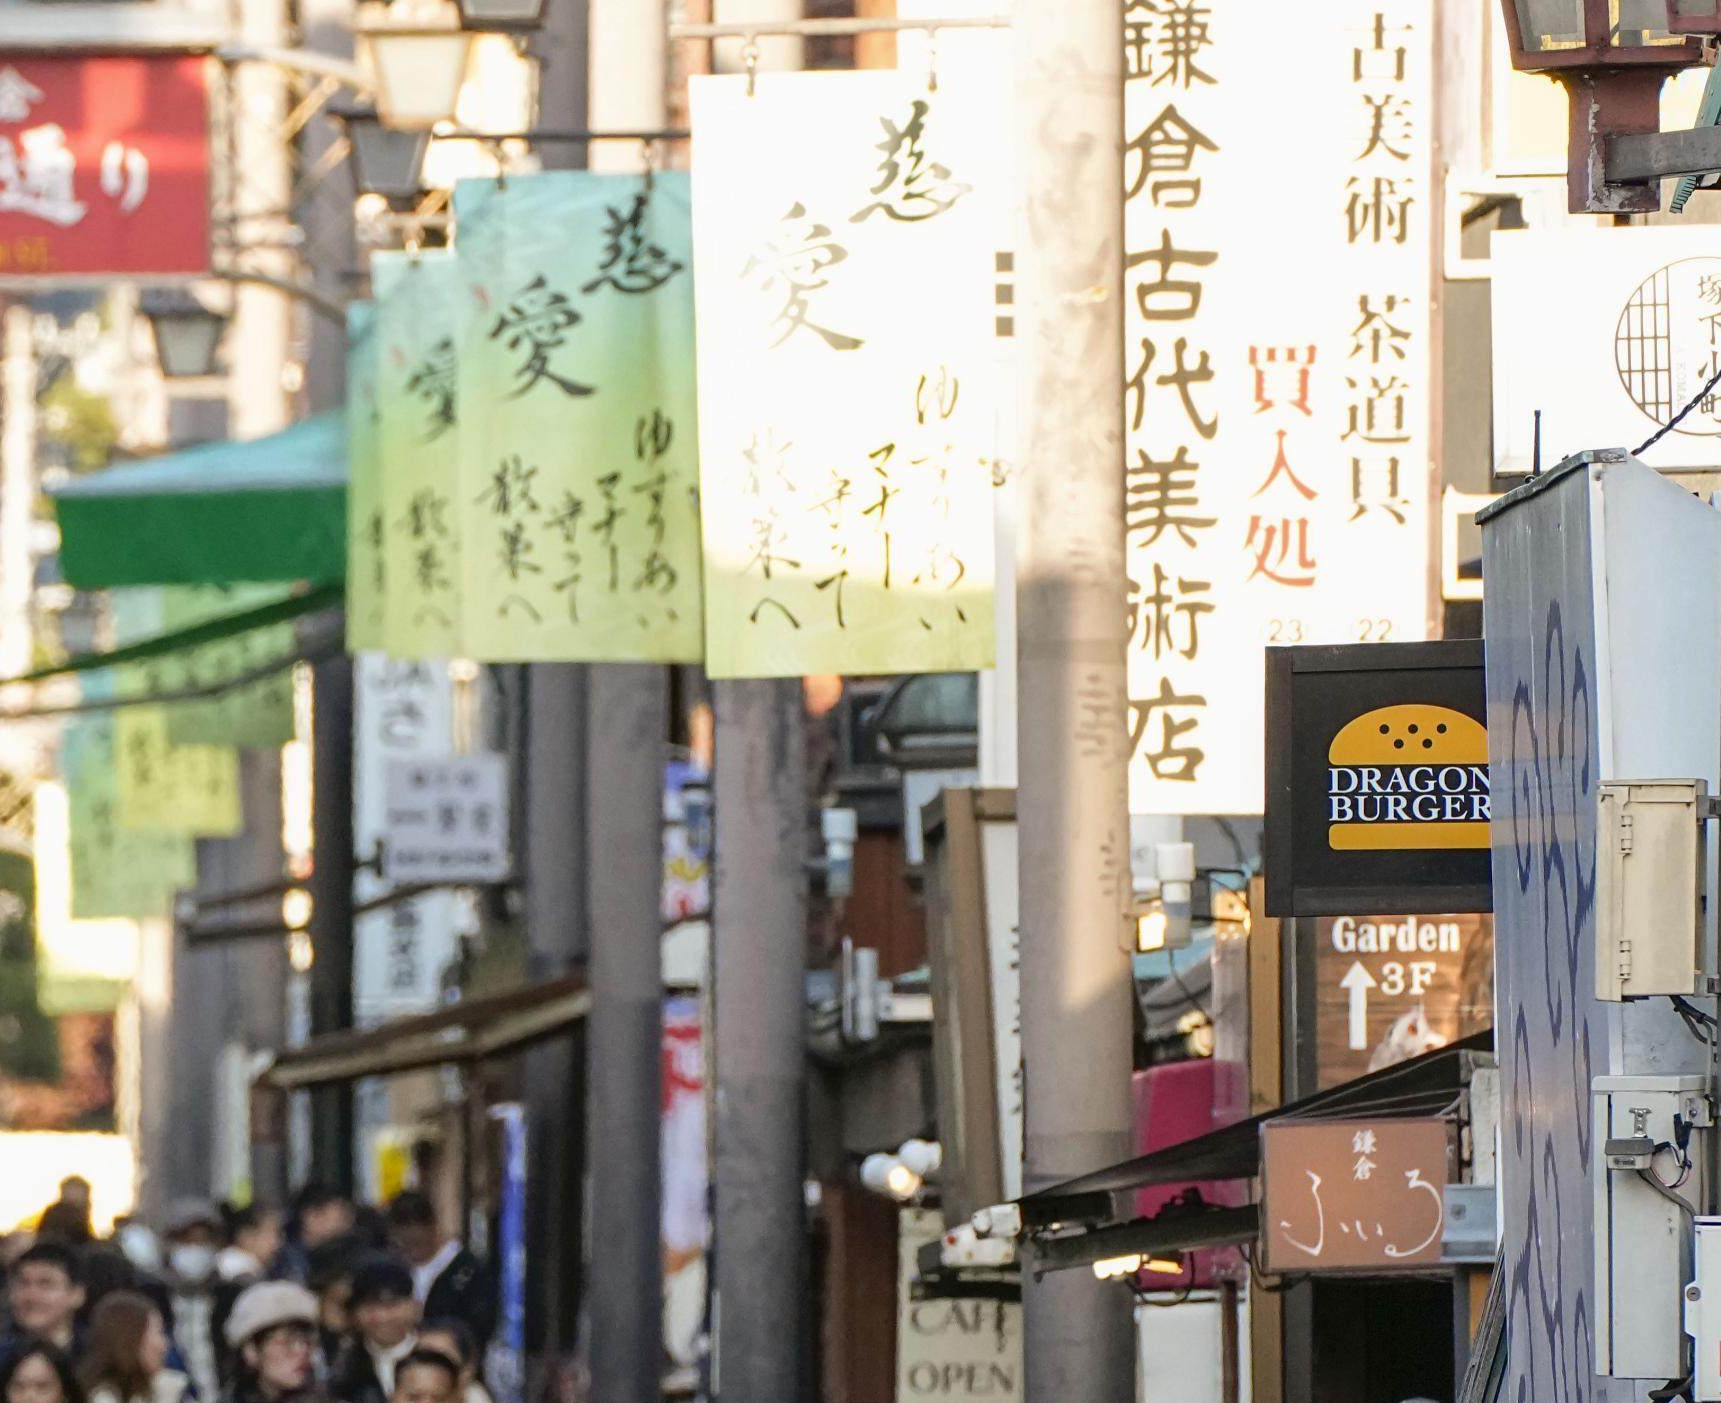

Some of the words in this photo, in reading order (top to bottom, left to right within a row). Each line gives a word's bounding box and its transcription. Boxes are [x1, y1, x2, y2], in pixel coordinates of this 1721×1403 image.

[1342, 12, 1415, 245] 古美術
[736, 200, 867, 352] 愛
[488, 270, 598, 400] 愛
[1124, 0, 1222, 782] 鎌倉古代美術店
[1339, 294, 1414, 526] 茶道具
[1243, 343, 1319, 588] 買入処
[1328, 767, 1491, 794] DRAGON
[1328, 794, 1492, 822] BURGER
[1331, 915, 1462, 953] Garden
[1380, 960, 1437, 996] 3F
[1352, 1128, 1378, 1182] 鎌倉
[908, 1360, 1016, 1395] OPEN
